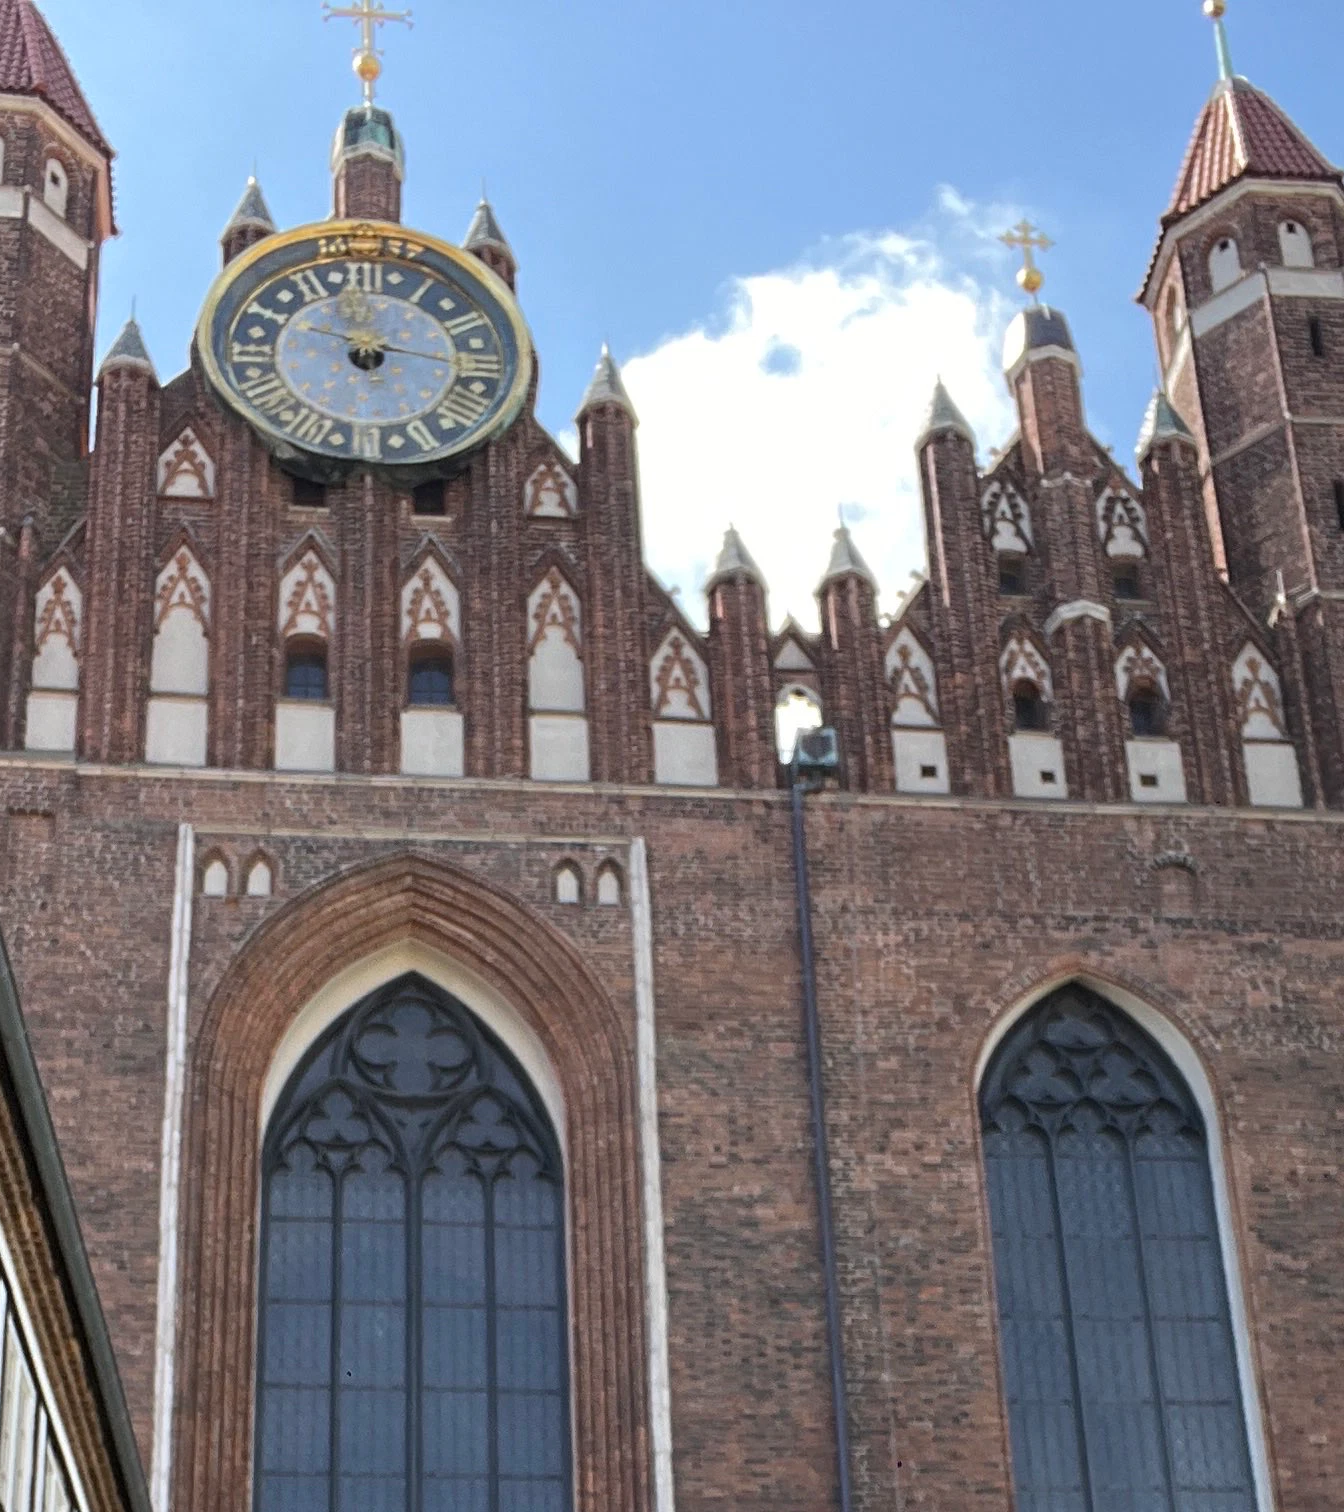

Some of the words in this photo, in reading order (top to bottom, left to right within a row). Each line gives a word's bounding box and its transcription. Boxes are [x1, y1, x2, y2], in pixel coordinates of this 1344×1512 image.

[290, 269, 330, 301] XI
[345, 262, 384, 294] XII
[410, 278, 435, 303] I
[247, 301, 290, 326] X
[444, 310, 487, 336] II
